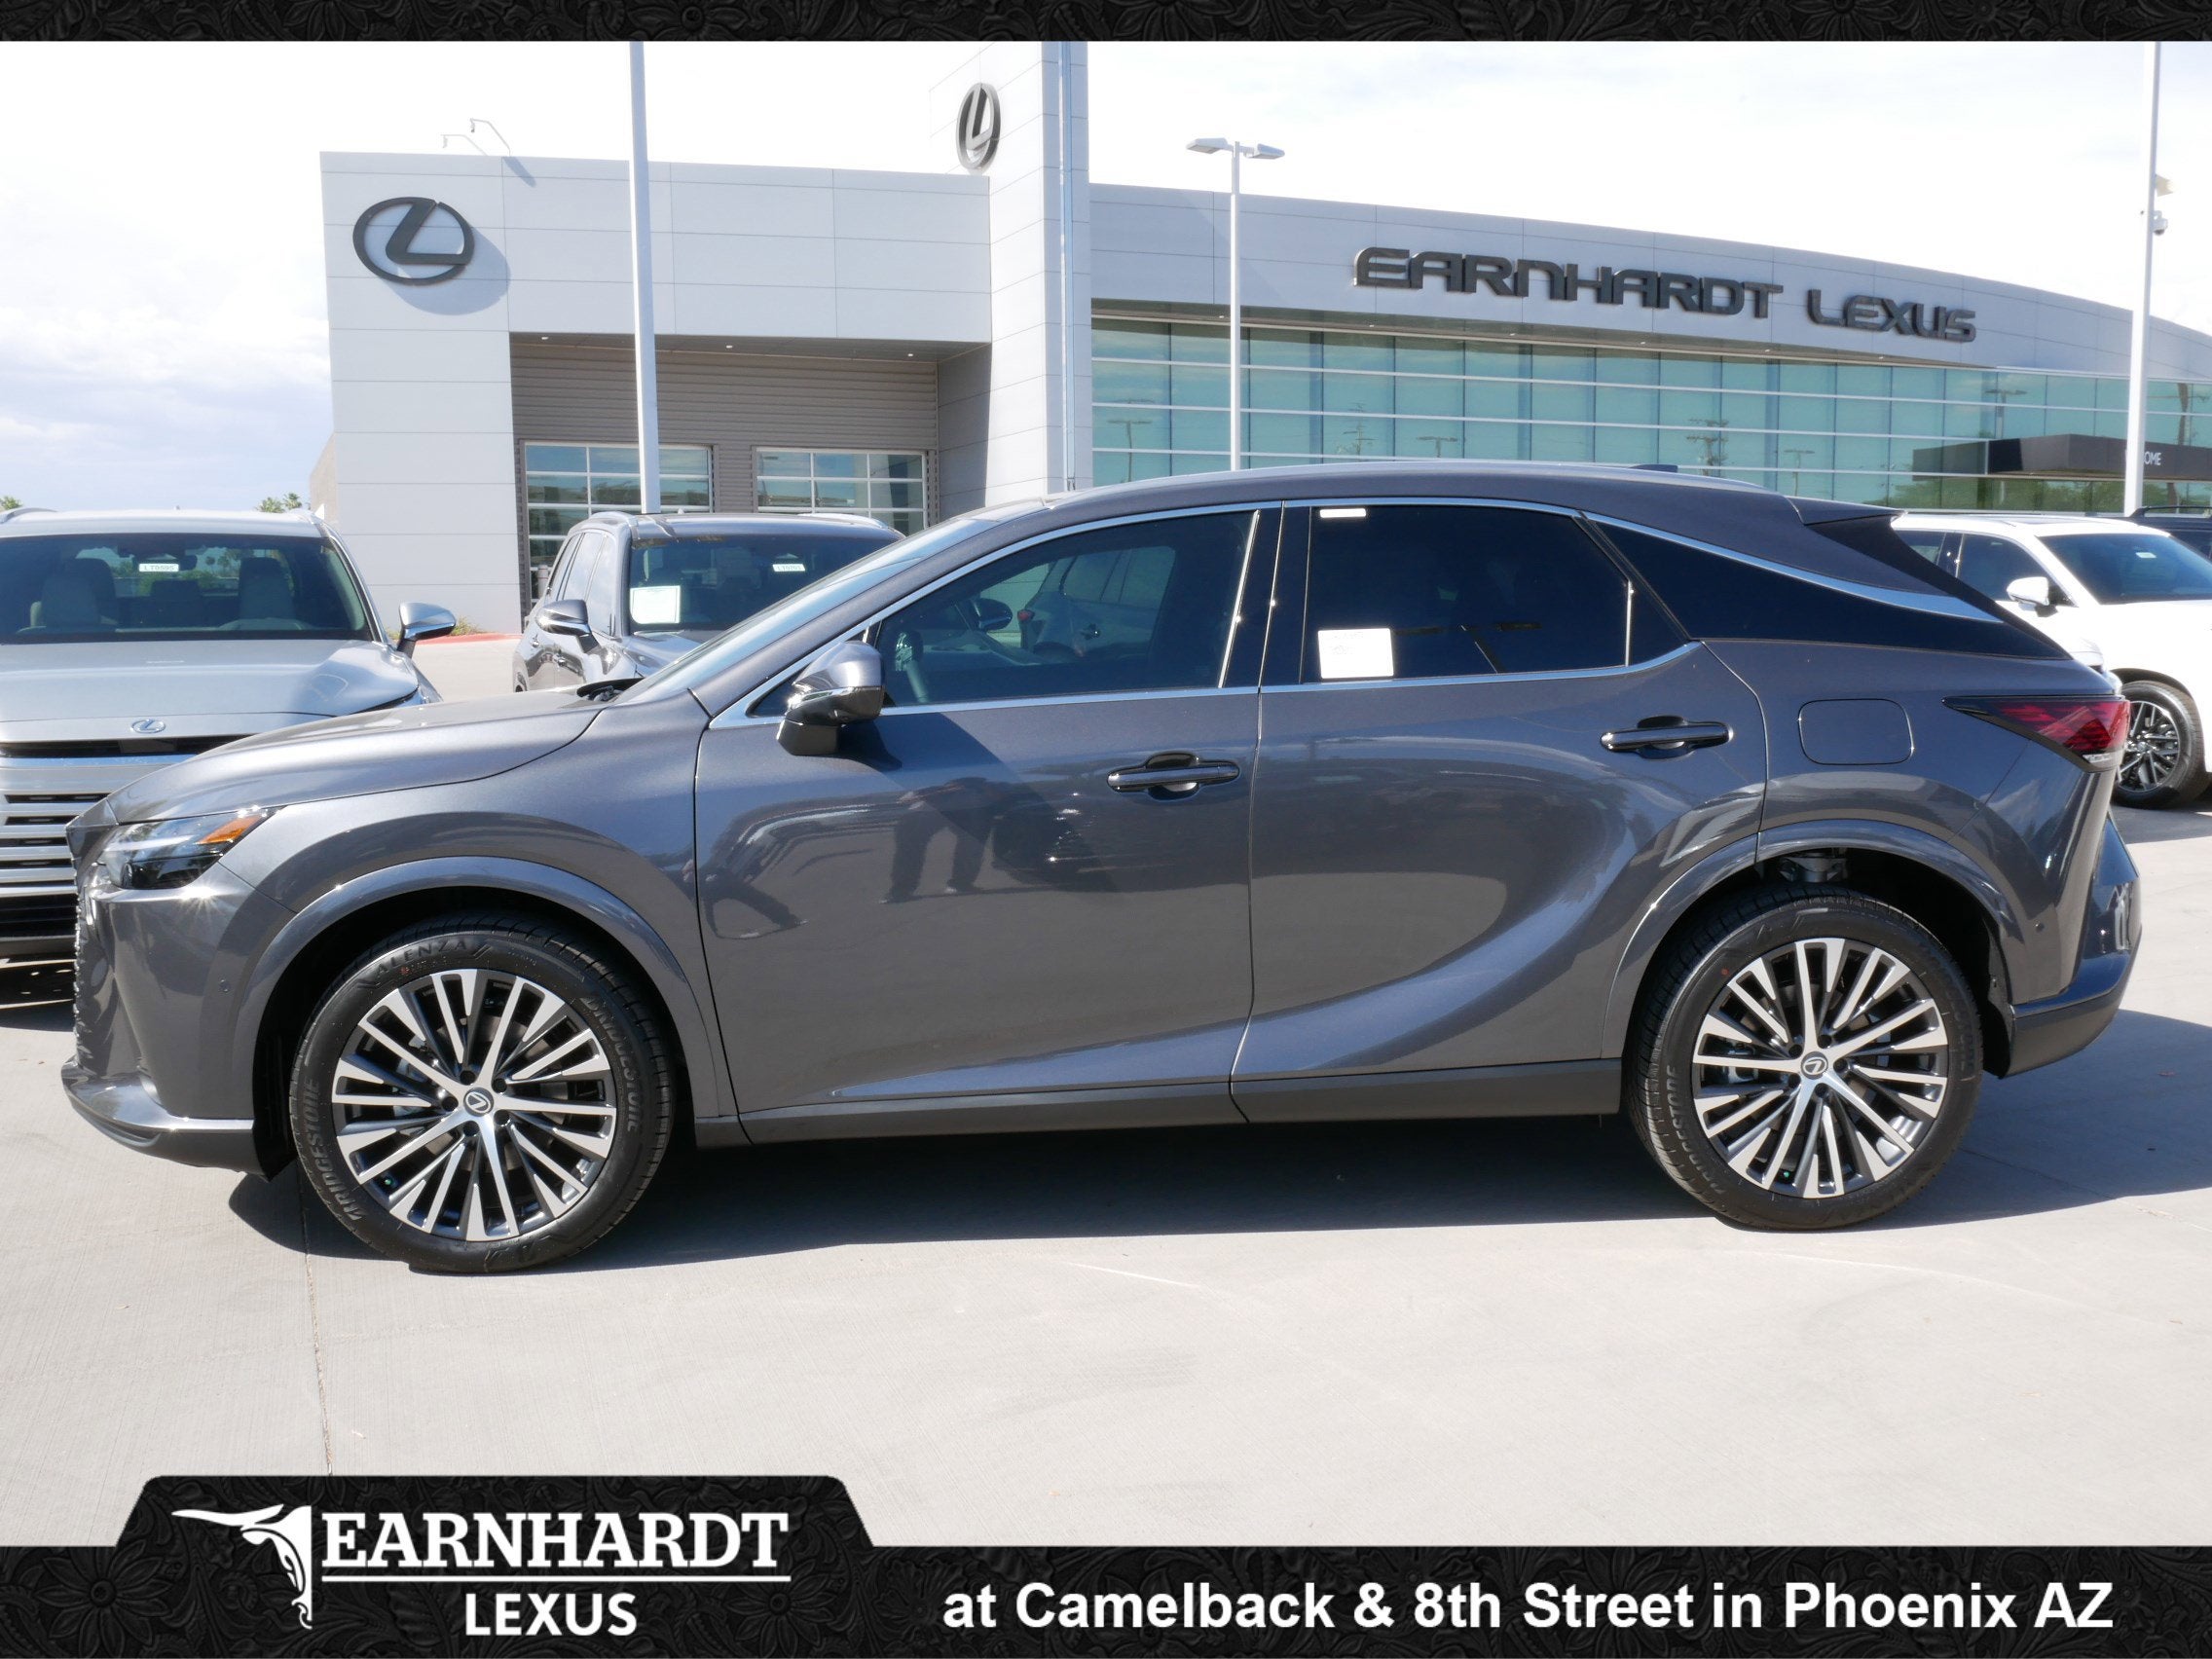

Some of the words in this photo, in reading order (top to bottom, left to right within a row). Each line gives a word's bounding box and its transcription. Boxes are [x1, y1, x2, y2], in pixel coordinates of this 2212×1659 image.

[1353, 246, 1784, 319] EARNHARDT
[1807, 289, 1976, 343] LEXUS
[377, 940, 467, 975] ALENZA
[303, 1078, 366, 1221] BRIDGESTONE
